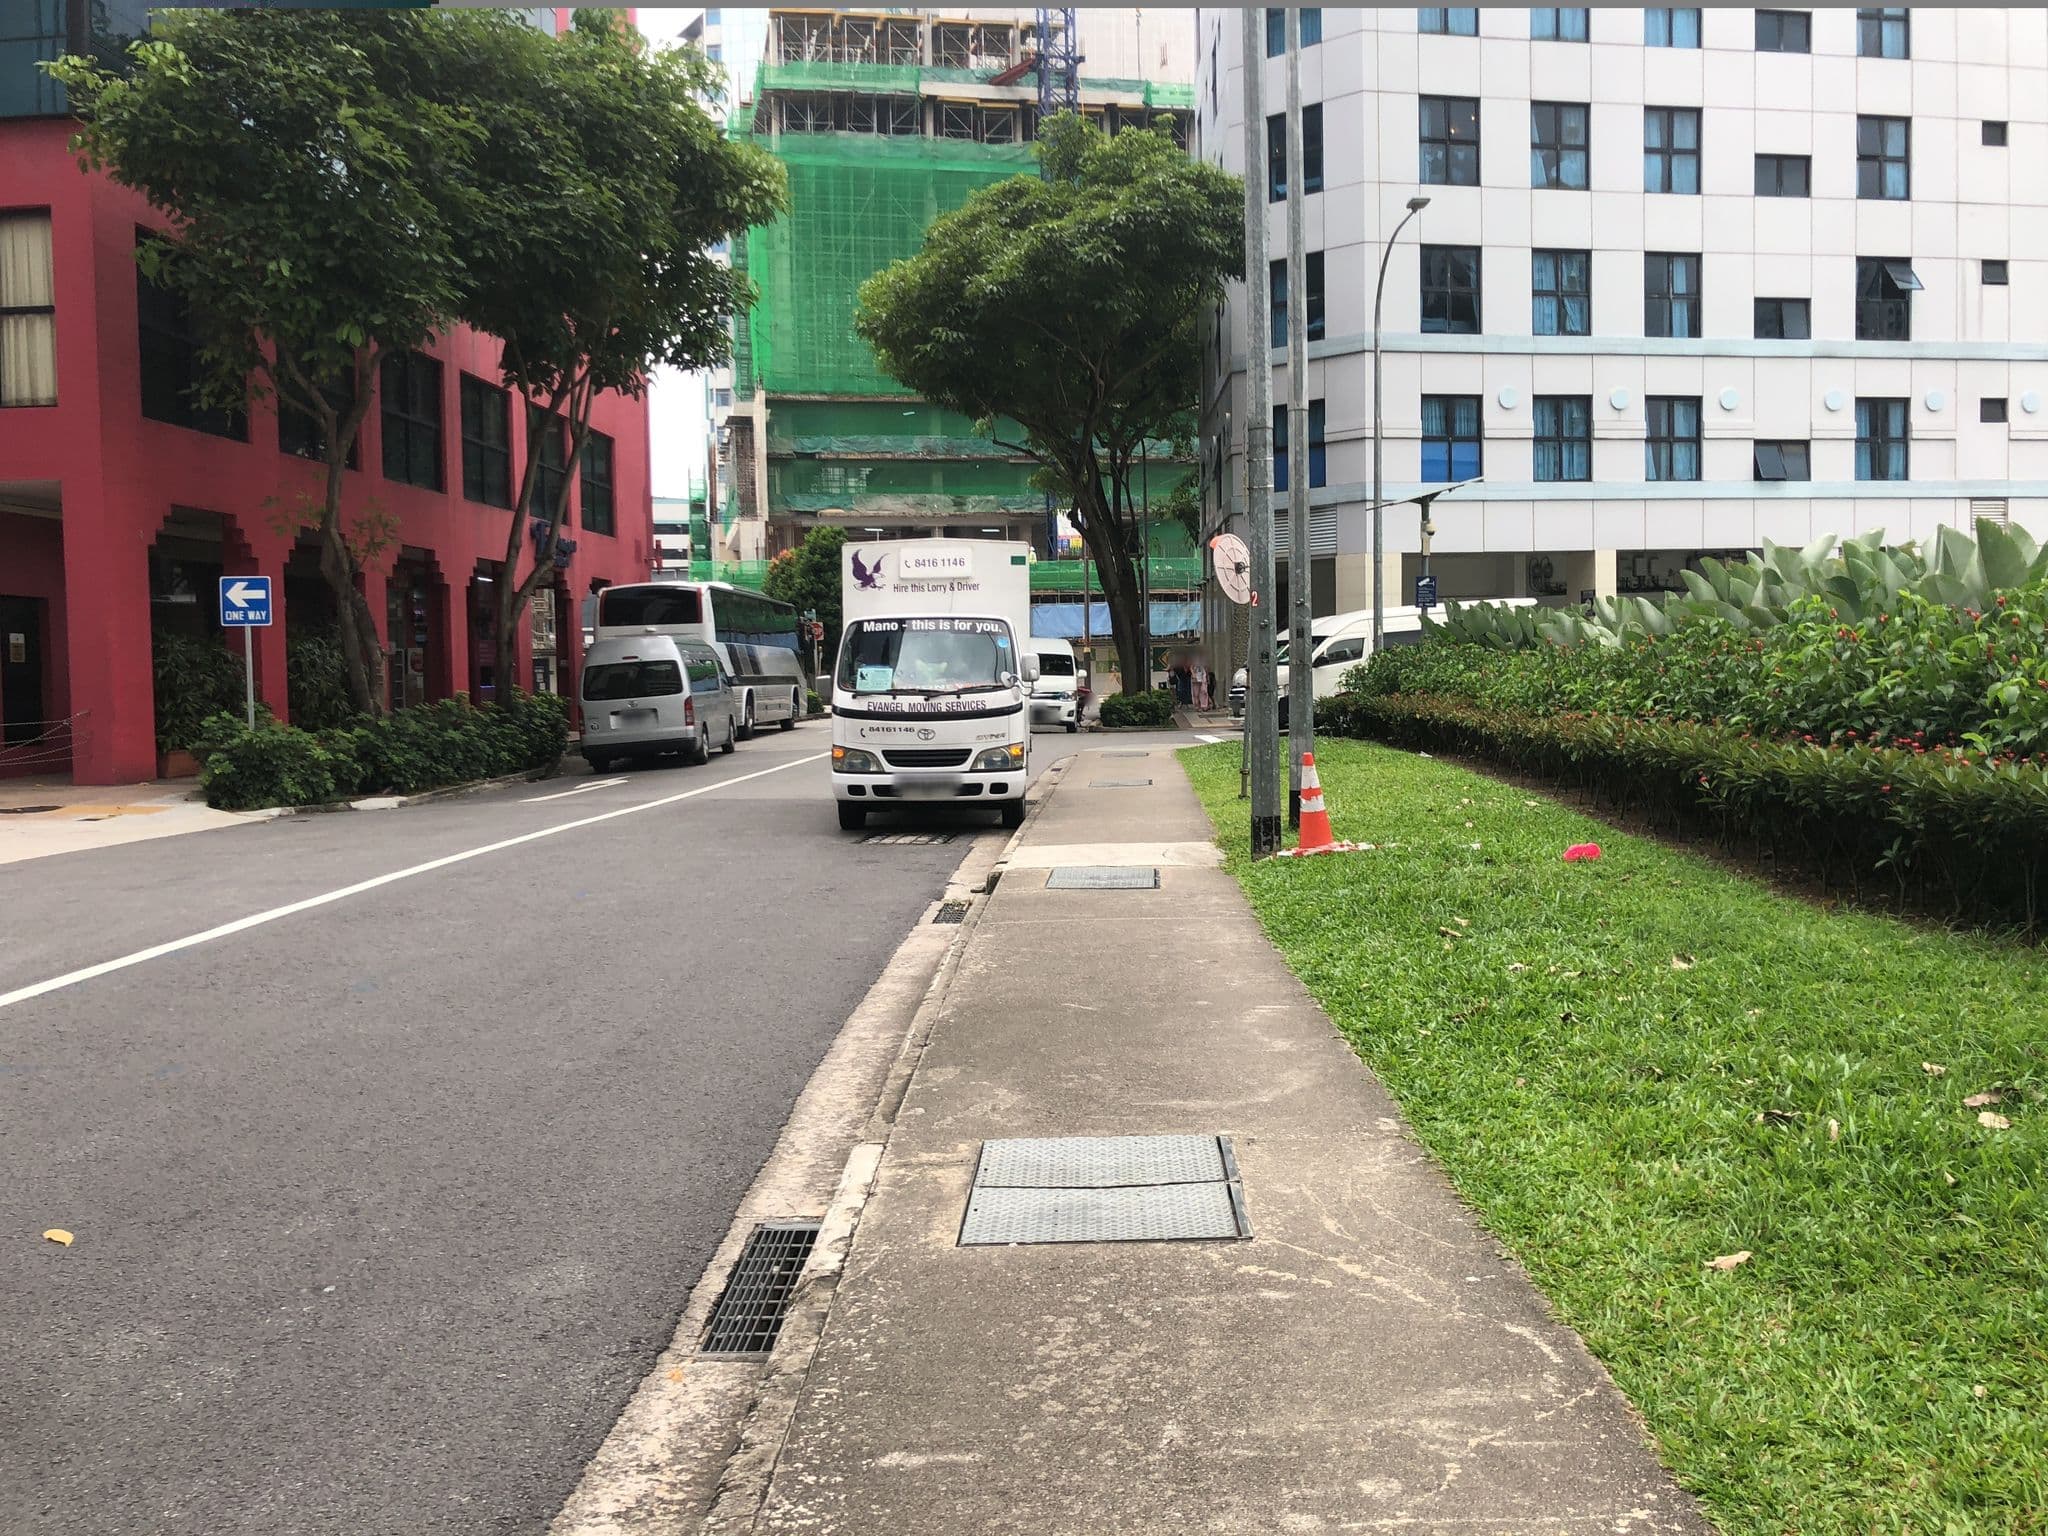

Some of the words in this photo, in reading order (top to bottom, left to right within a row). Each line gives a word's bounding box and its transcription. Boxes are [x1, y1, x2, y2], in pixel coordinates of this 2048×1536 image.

[915, 558, 938, 568] 8416
[940, 557, 965, 567] 1146
[893, 583, 909, 593] Hire
[911, 583, 926, 593] this
[927, 583, 947, 594] Lorry
[949, 582, 955, 592] &
[957, 581, 980, 592] Driver
[1251, 590, 1258, 607] 2
[225, 611, 245, 621] ONE
[247, 611, 267, 620] WAY
[863, 620, 899, 633] Mano
[911, 619, 936, 631] this
[939, 619, 951, 630] is
[954, 619, 972, 631] for
[976, 621, 1002, 634] you.
[867, 701, 905, 712] EVANGEL
[908, 702, 942, 712] MOVING
[945, 700, 987, 712] SERVICES
